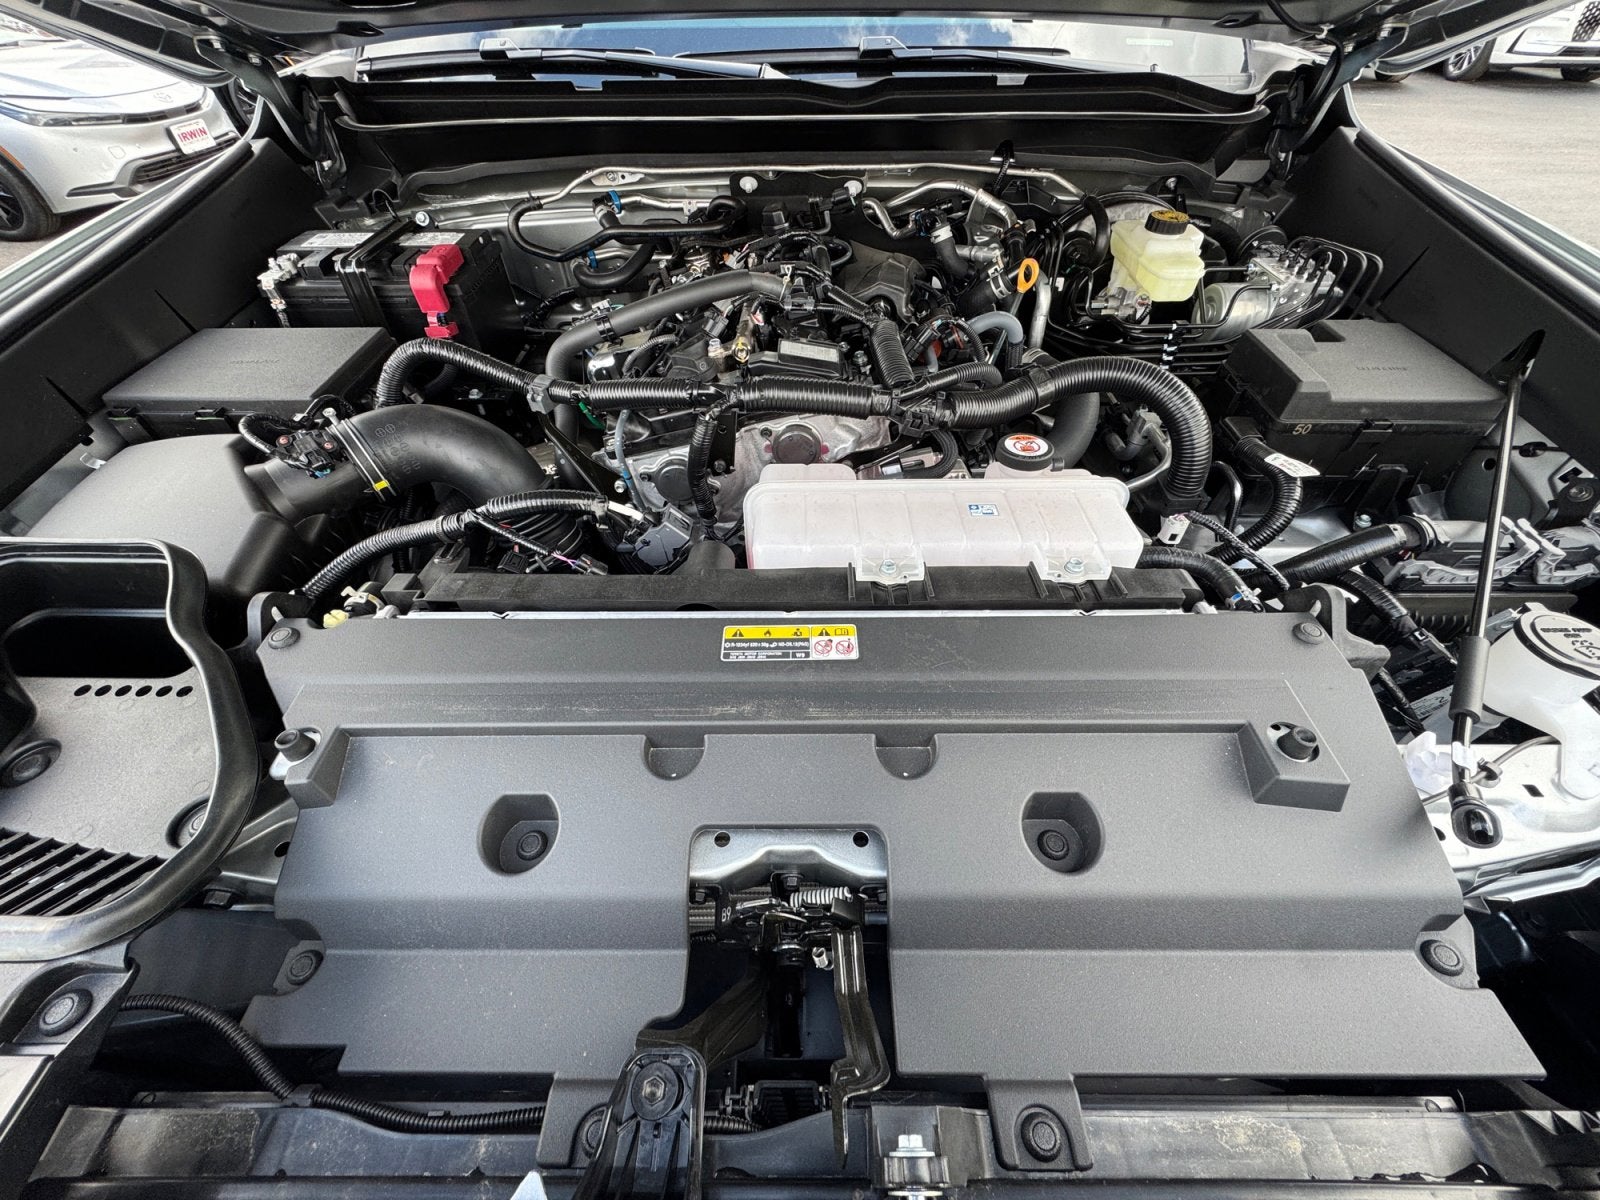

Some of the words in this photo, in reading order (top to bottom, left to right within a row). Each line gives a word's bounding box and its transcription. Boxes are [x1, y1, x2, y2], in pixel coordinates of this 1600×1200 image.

[178, 127, 208, 142] IRWIN
[1292, 424, 1313, 435] 50
[721, 906, 732, 922] B9
